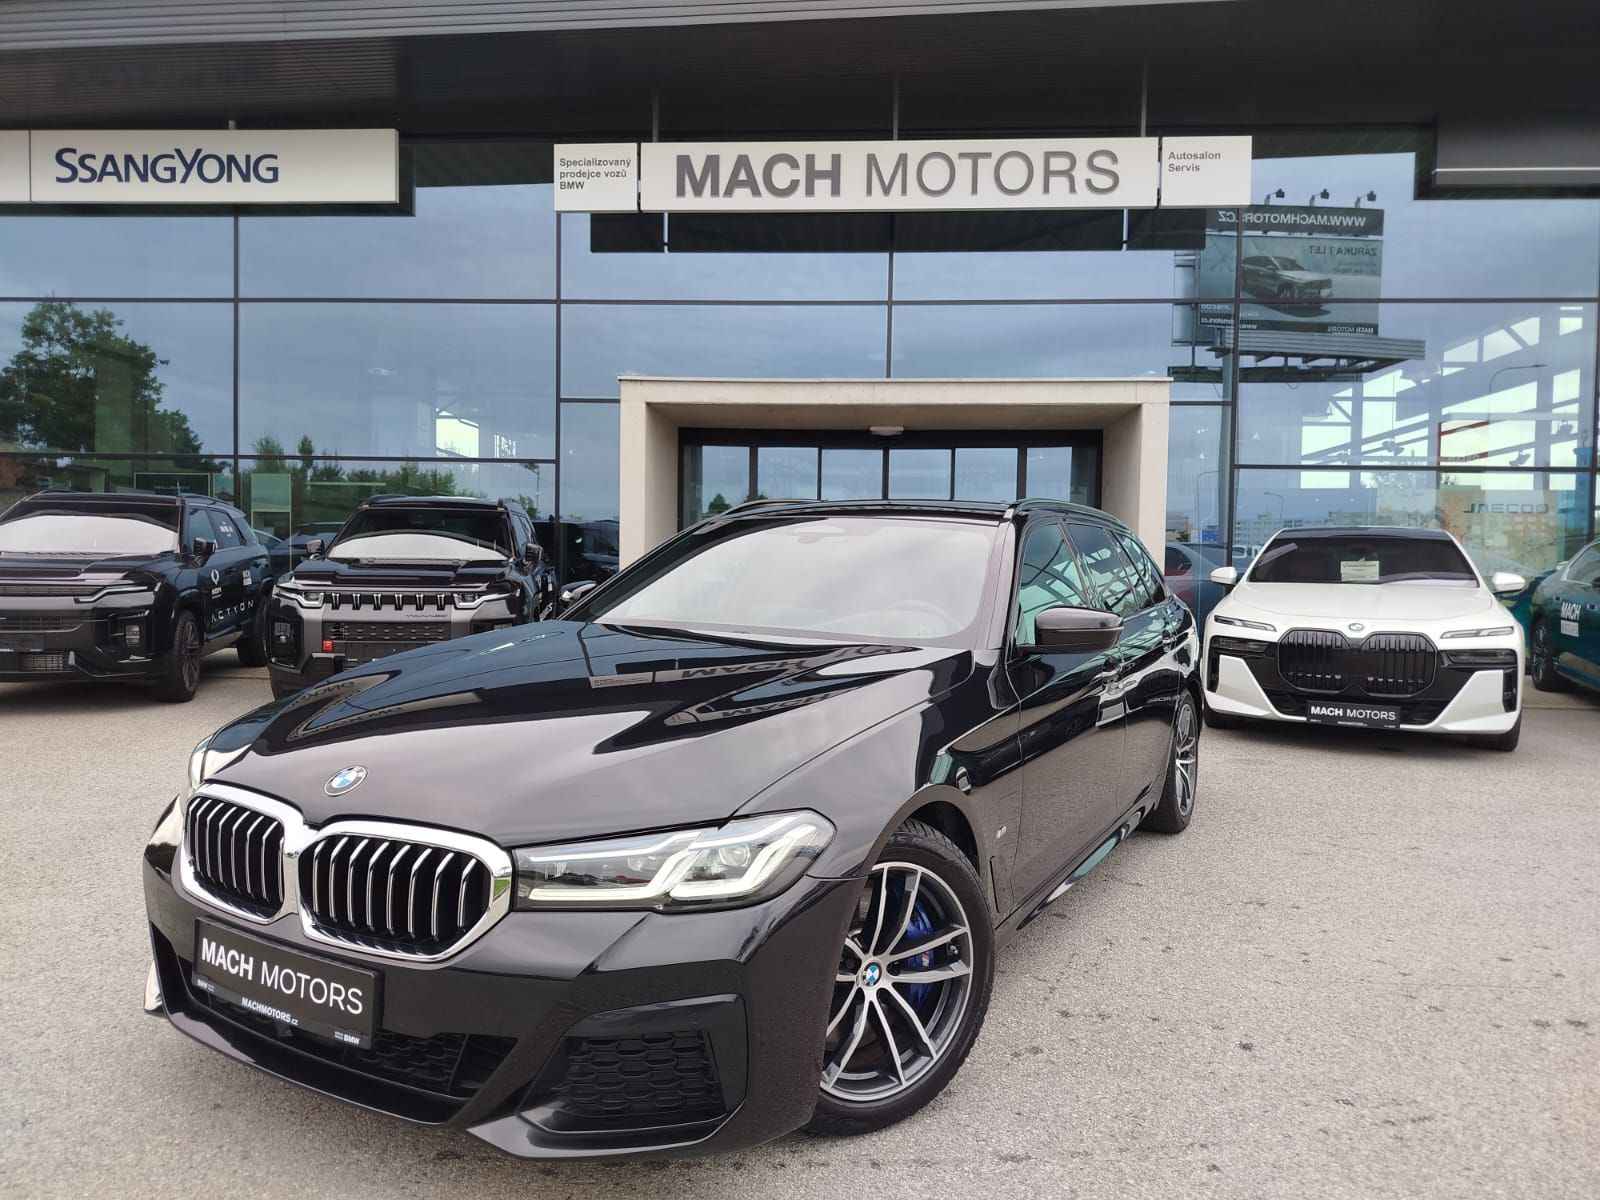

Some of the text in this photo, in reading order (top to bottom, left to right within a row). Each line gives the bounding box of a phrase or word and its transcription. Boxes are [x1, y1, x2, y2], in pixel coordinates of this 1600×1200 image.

[1168, 151, 1221, 160] Autosalon
[559, 157, 631, 168] Specializovaný
[1168, 163, 1201, 172] Servis
[559, 168, 627, 180] prodejce vozů
[675, 149, 1120, 198] MACH MOTORS
[559, 181, 585, 190] BMW
[1310, 706, 1396, 720] MACH MOTORS
[202, 937, 363, 1015] MACH MOTORS
[343, 1033, 360, 1045] BMW
